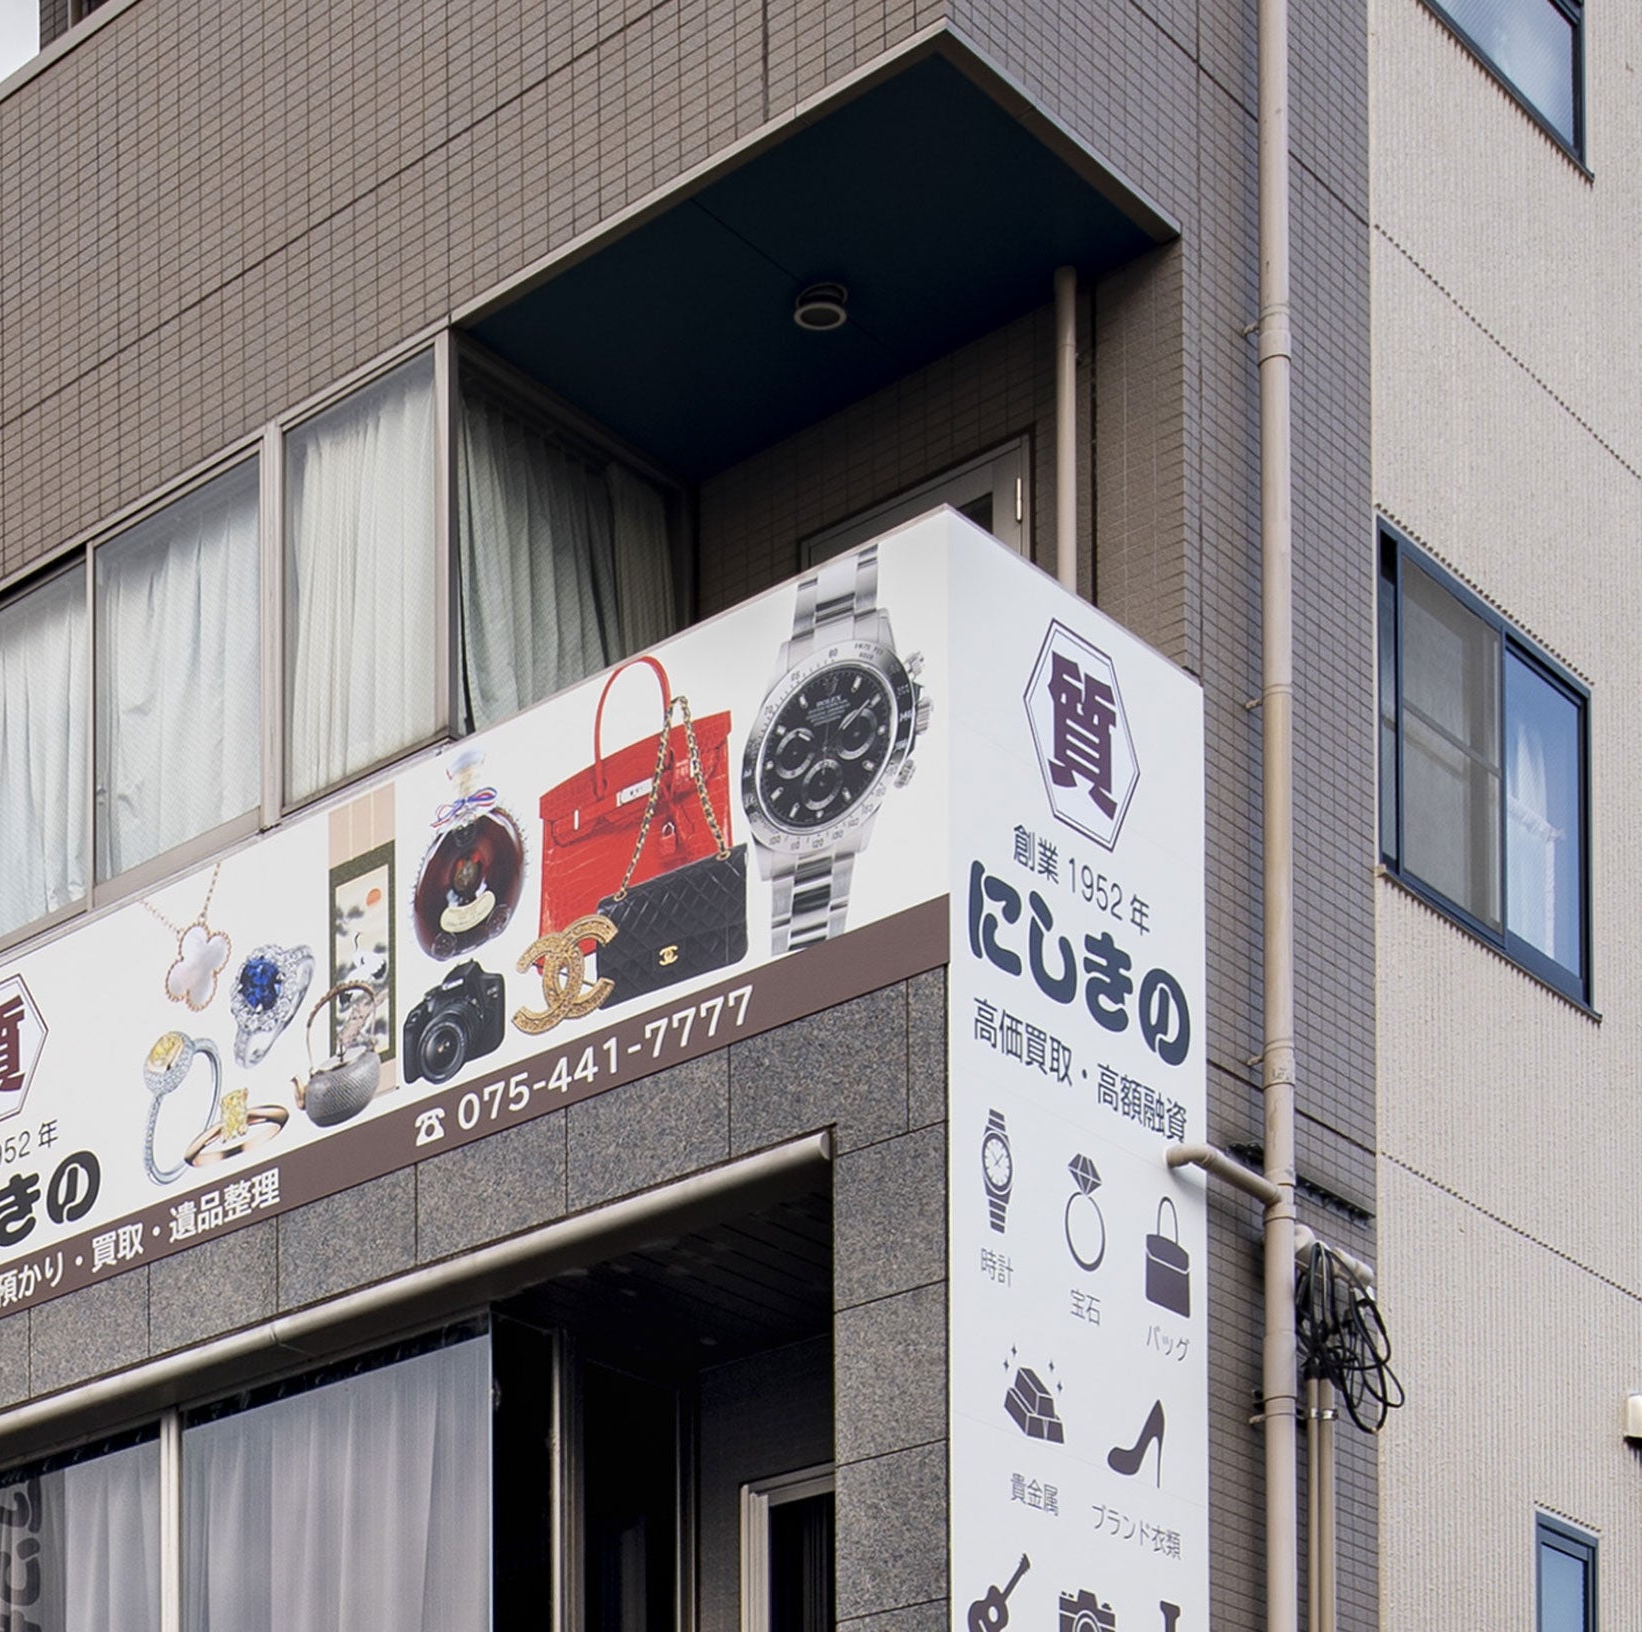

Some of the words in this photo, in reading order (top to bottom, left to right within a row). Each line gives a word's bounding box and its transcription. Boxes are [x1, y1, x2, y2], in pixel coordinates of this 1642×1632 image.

[1047, 650, 1118, 821] 質
[1013, 825, 1059, 883] 創業
[1069, 857, 1123, 922] 1952
[1130, 893, 1151, 936] 年
[968, 860, 1191, 1067] にしきの
[458, 985, 754, 1131] 075-441-7777
[38, 1119, 58, 1148] 年
[980, 1248, 1014, 1288] 時計
[1070, 1289, 1101, 1326] 宝石
[1146, 1325, 1190, 1361] バッグ
[1010, 1473, 1058, 1517] 貴金属
[1092, 1503, 1181, 1561] ブランド衣類
